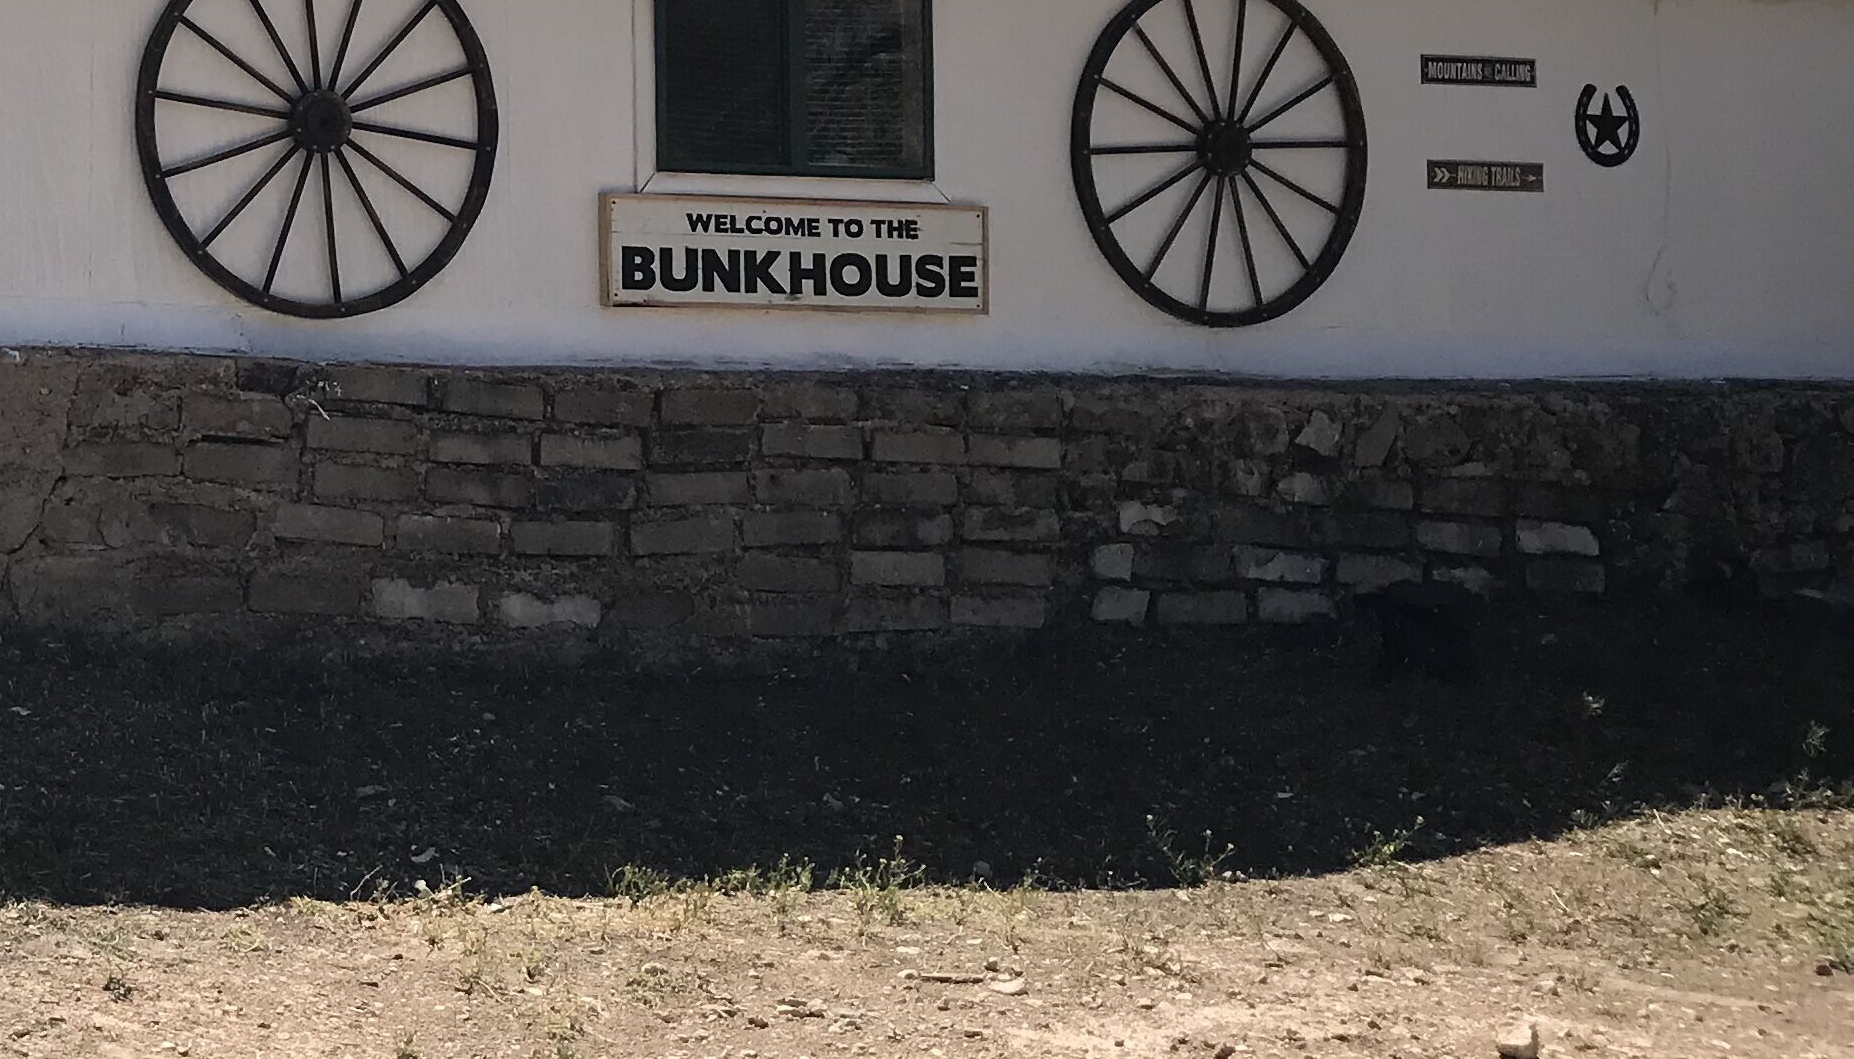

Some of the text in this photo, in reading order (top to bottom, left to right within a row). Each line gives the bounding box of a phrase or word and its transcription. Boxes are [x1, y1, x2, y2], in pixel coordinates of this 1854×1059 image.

[1427, 61, 1483, 80] MOUNTAINS
[1494, 64, 1531, 82] CALLING
[1457, 166, 1521, 187] HIKING TRAILS
[686, 213, 919, 240] WELCOME TO THE
[621, 245, 979, 298] BUNKHOUSE
